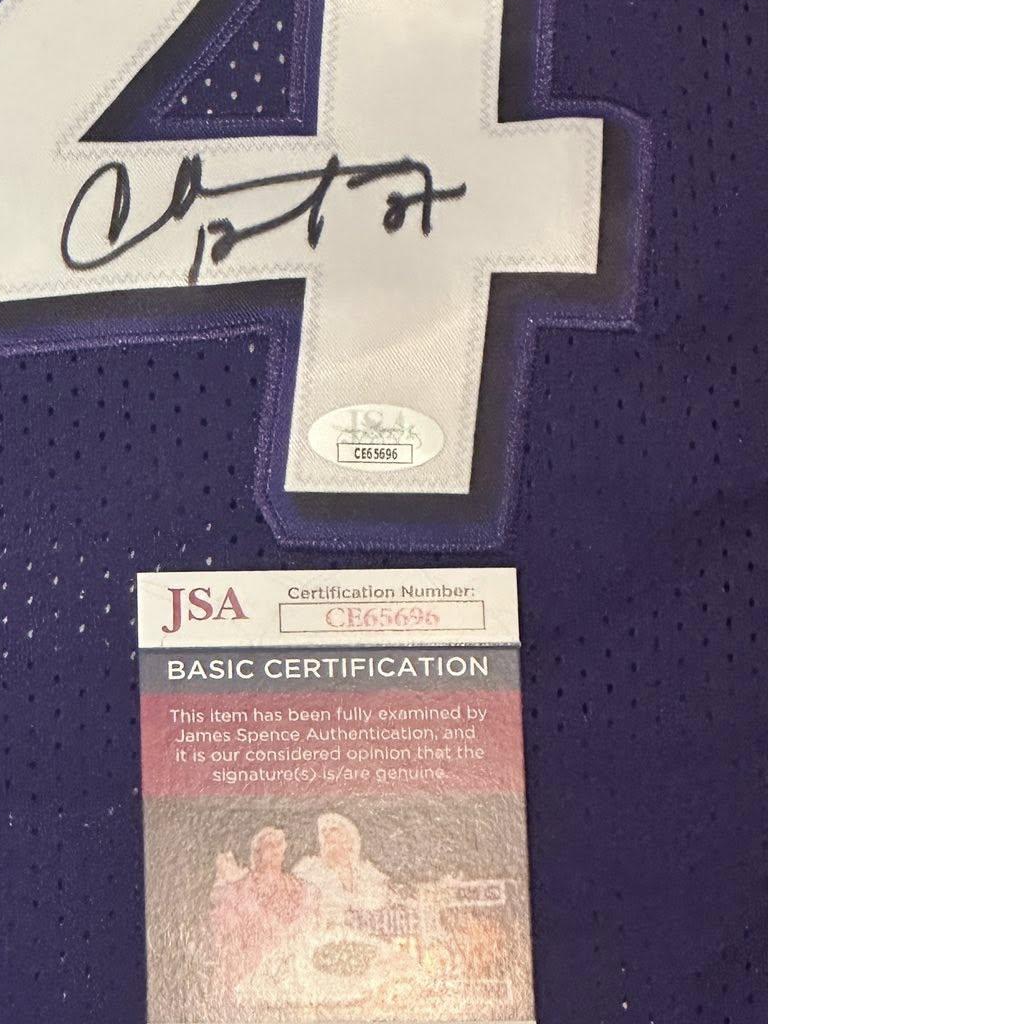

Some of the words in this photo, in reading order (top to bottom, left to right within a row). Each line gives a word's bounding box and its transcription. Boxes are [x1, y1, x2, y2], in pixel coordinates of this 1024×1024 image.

[354, 448, 398, 459] CE65696
[288, 585, 395, 600] Certification
[402, 585, 475, 599] Number:
[162, 587, 249, 634] JSA
[325, 606, 440, 628] CE65696
[168, 659, 255, 680] BASIC
[264, 656, 489, 679] CERTIFICATION
[170, 709, 205, 723] This
[211, 709, 248, 722] item
[254, 708, 282, 722] has
[289, 707, 330, 721] been
[336, 707, 371, 723] fully
[378, 706, 461, 720] examined
[467, 706, 487, 723] by
[176, 729, 230, 744] James
[236, 728, 300, 745] Spence
[443, 726, 476, 740] and
[175, 748, 187, 762] it
[193, 748, 205, 762] is
[211, 750, 240, 762] our
[246, 746, 341, 762] considered
[347, 746, 412, 764] opinion
[417, 745, 450, 760] that
[456, 745, 484, 759] the
[212, 766, 316, 783] signature(s)
[322, 766, 370, 782] is/are
